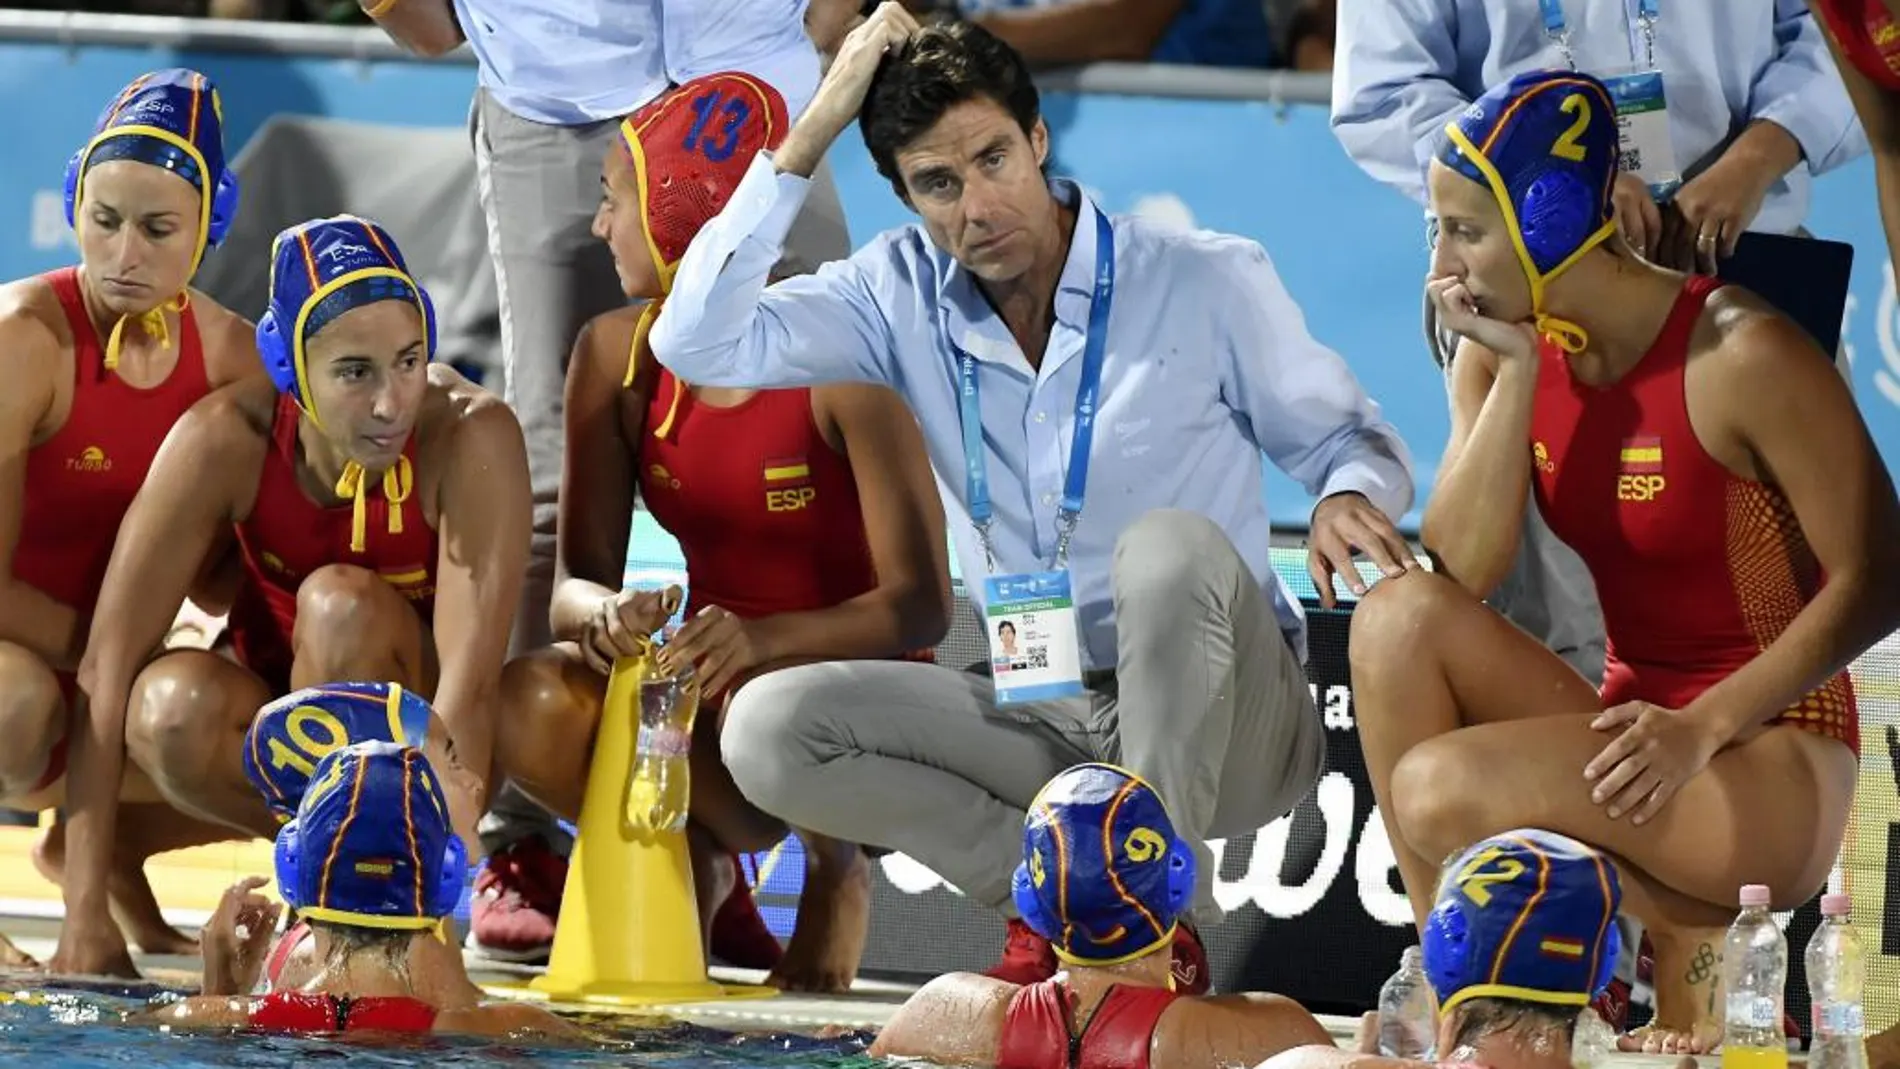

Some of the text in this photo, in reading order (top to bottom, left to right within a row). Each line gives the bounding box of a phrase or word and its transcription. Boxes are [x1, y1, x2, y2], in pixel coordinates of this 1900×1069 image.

[683, 90, 749, 161] 13
[1550, 93, 1592, 161] 2
[766, 487, 817, 512] ESP
[1617, 474, 1666, 501] ESP
[267, 706, 348, 776] 10
[1124, 826, 1167, 863] 9
[1456, 846, 1525, 909] 12
